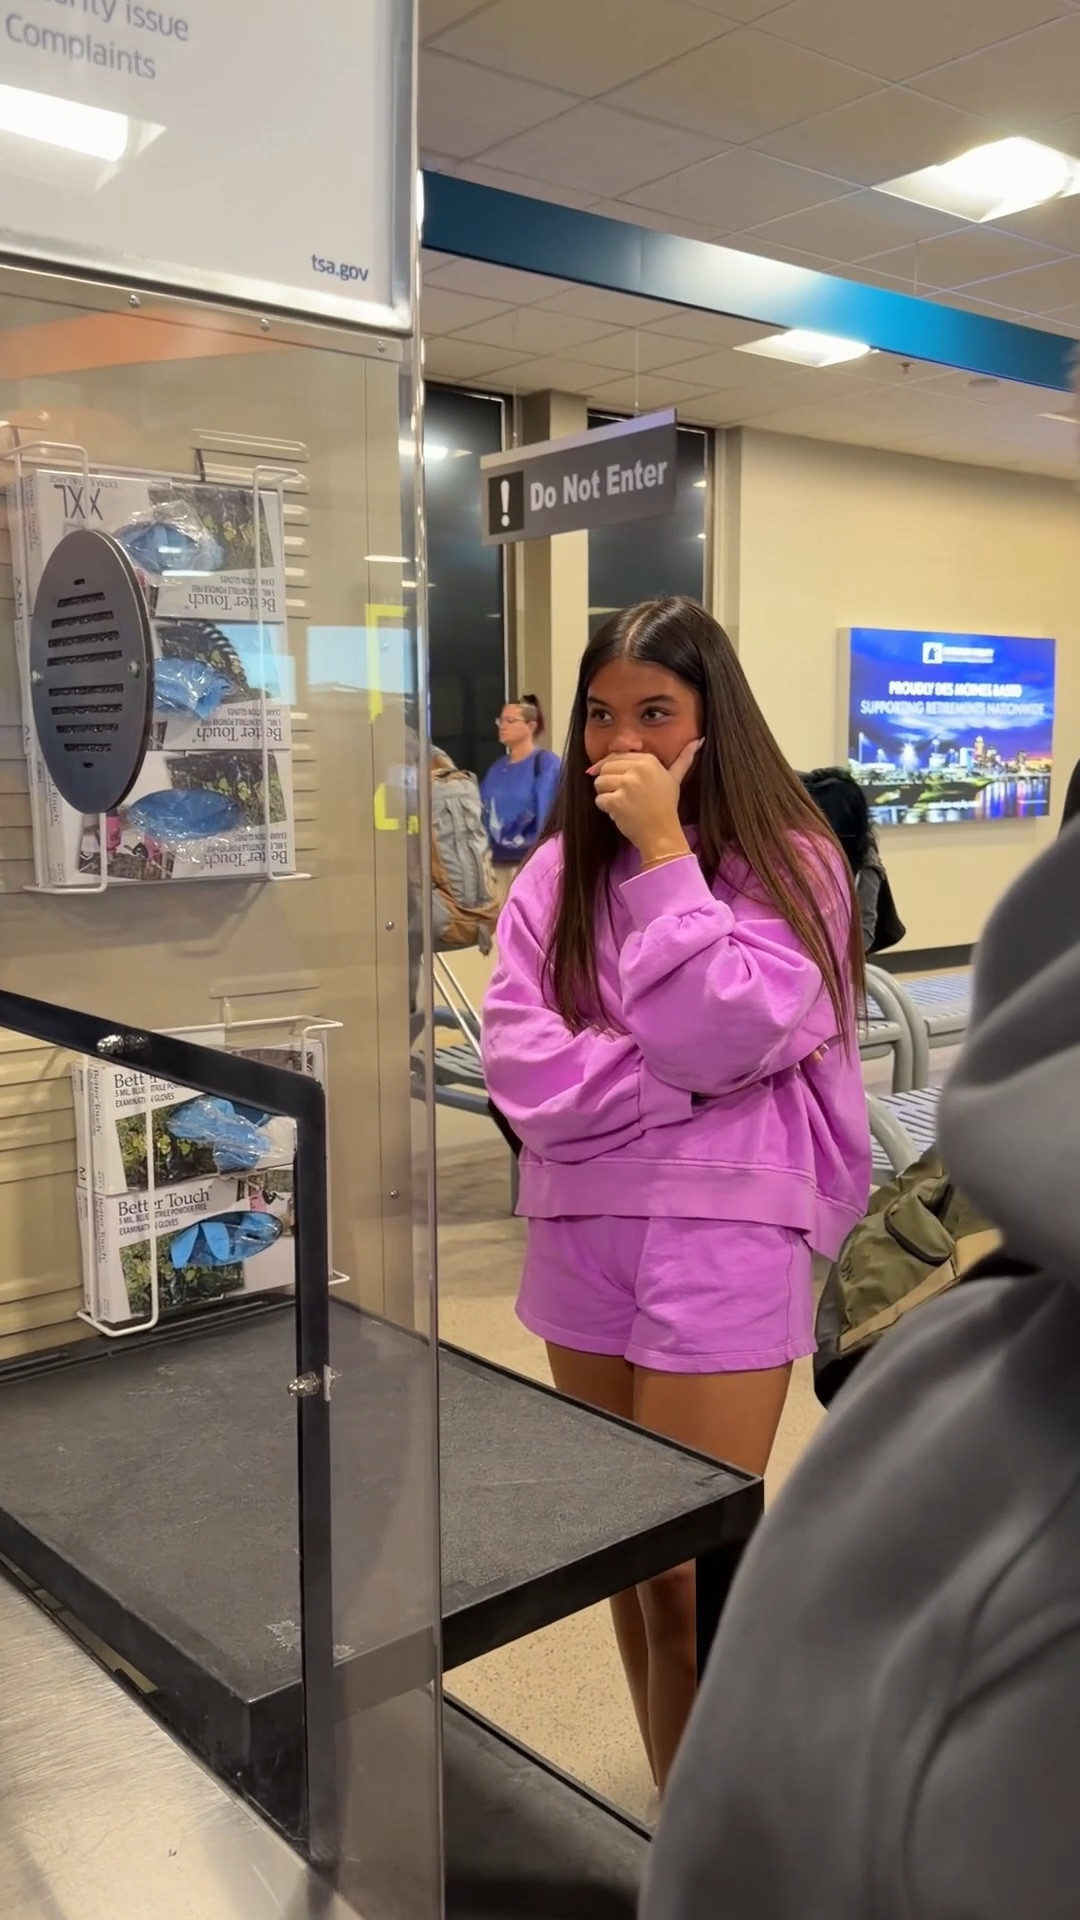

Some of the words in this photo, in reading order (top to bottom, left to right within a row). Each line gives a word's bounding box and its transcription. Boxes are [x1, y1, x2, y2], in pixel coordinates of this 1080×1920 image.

[126, 2, 188, 41] issue
[6, 13, 156, 80] Complaints
[312, 254, 368, 282] tsa.gov
[530, 482, 556, 511] Do
[563, 470, 600, 504] Not
[606, 460, 668, 496] Enter
[54, 484, 103, 520] XXL
[188, 593, 232, 610] Touch
[196, 727, 238, 742] Touch
[240, 727, 282, 742] Beter
[247, 850, 288, 864] Beter
[165, 1188, 210, 1208] Touch
[172, 1206, 194, 1215] POWDER
